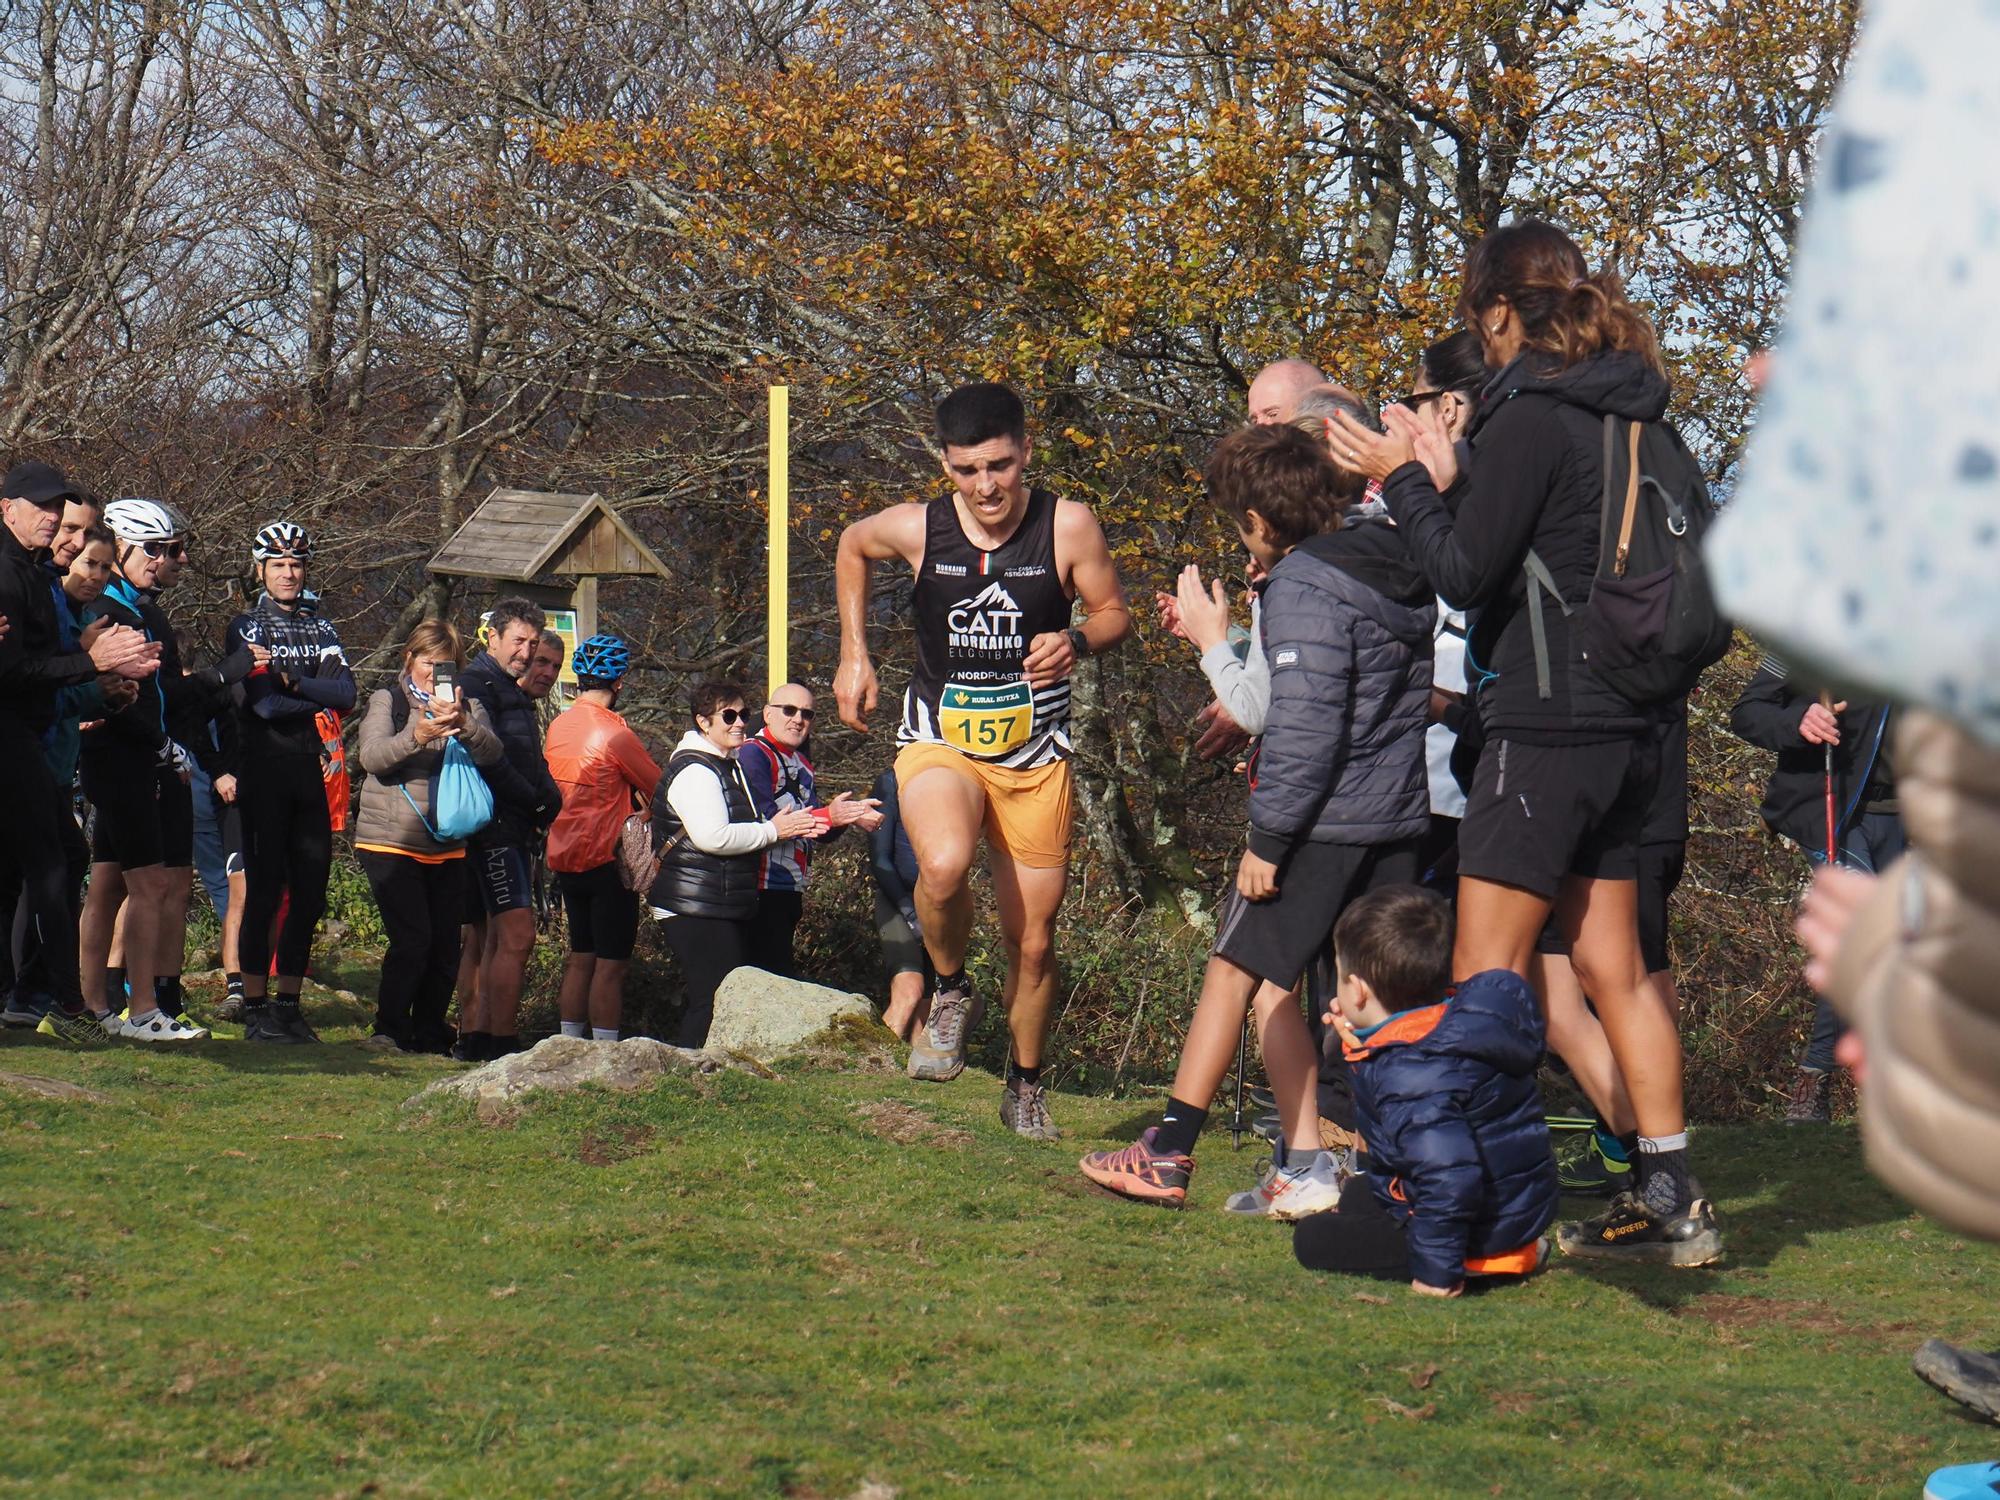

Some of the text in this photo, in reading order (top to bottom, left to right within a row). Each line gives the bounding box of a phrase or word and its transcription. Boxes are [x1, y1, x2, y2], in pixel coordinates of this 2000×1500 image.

[935, 563, 967, 573] MORKAIKO
[947, 609, 1023, 635] CATT
[948, 632, 1023, 650] MORKAIKO
[948, 646, 1023, 660] ELGOIBAR
[957, 671, 1023, 681] NORDPLASTI
[971, 693, 1020, 704] RURAL KUTXA
[958, 716, 1017, 745] 157
[485, 846, 513, 905] Azpiru
